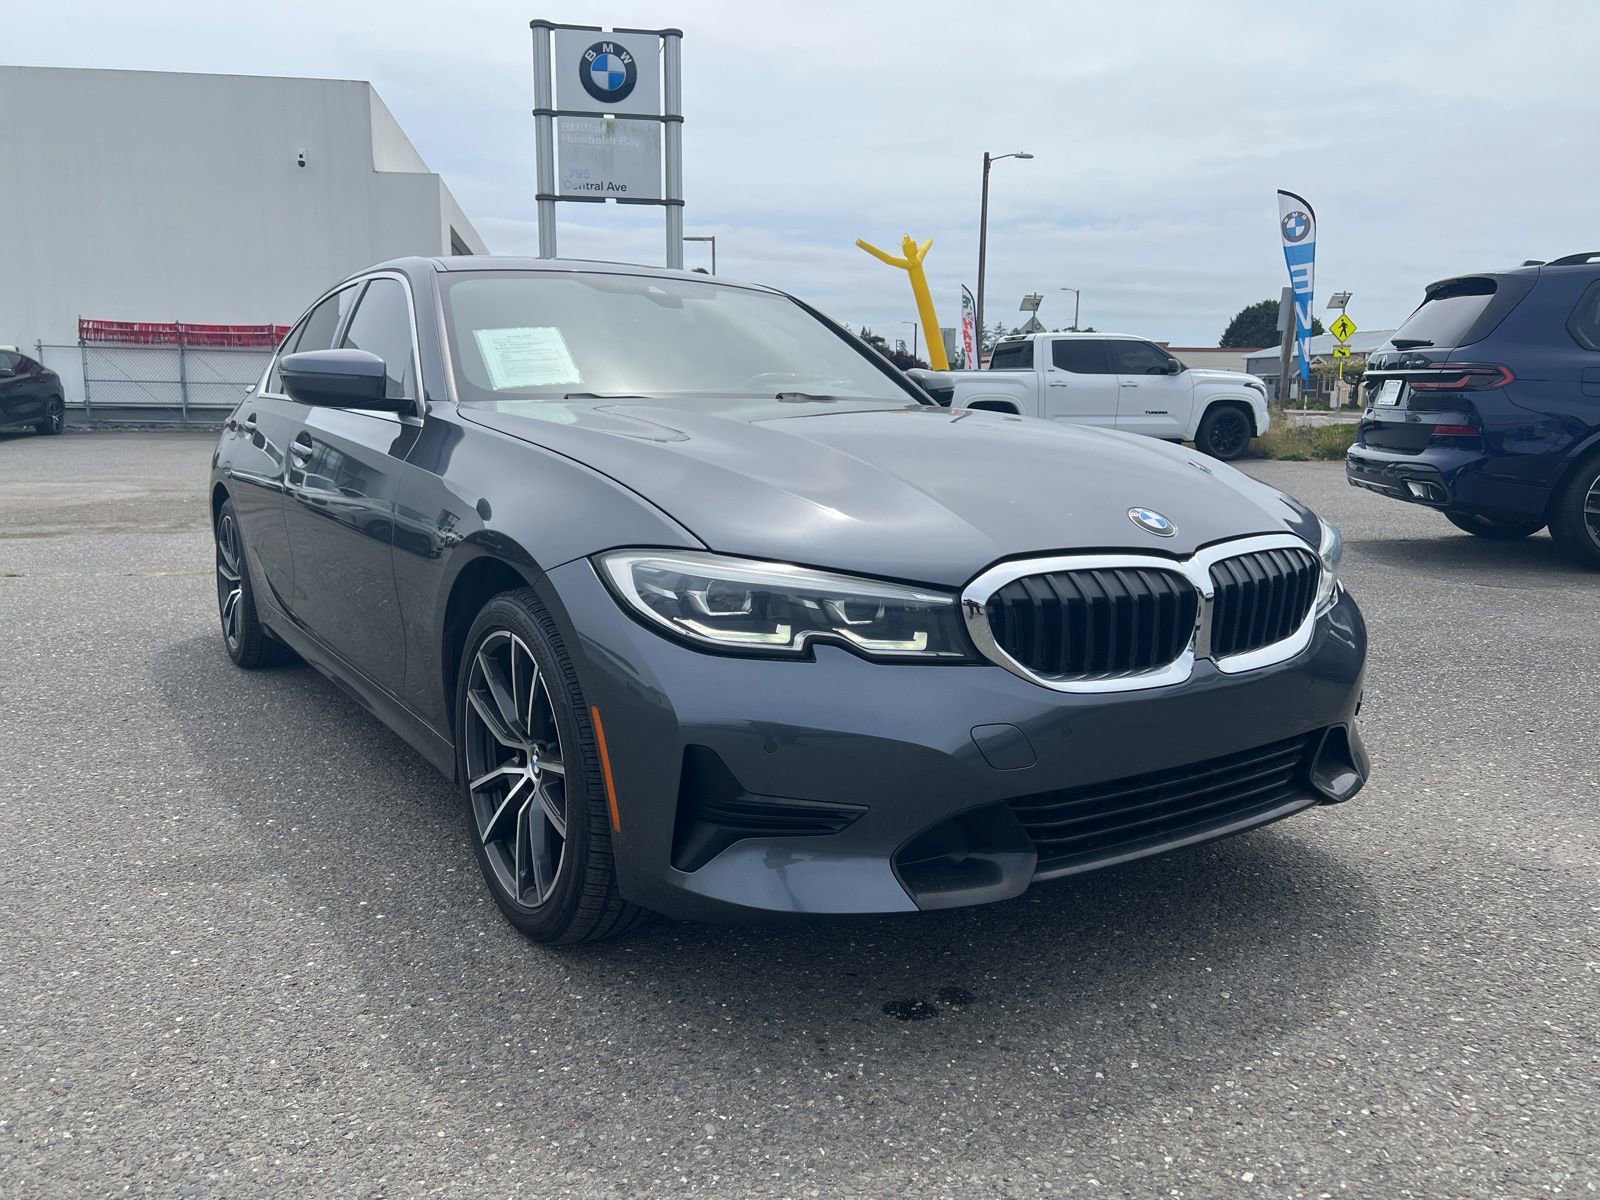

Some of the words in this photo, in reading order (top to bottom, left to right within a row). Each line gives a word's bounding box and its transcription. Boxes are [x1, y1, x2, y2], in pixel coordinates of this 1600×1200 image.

[585, 43, 632, 65] BMW
[564, 180, 604, 191] Central
[607, 181, 627, 192] Ave
